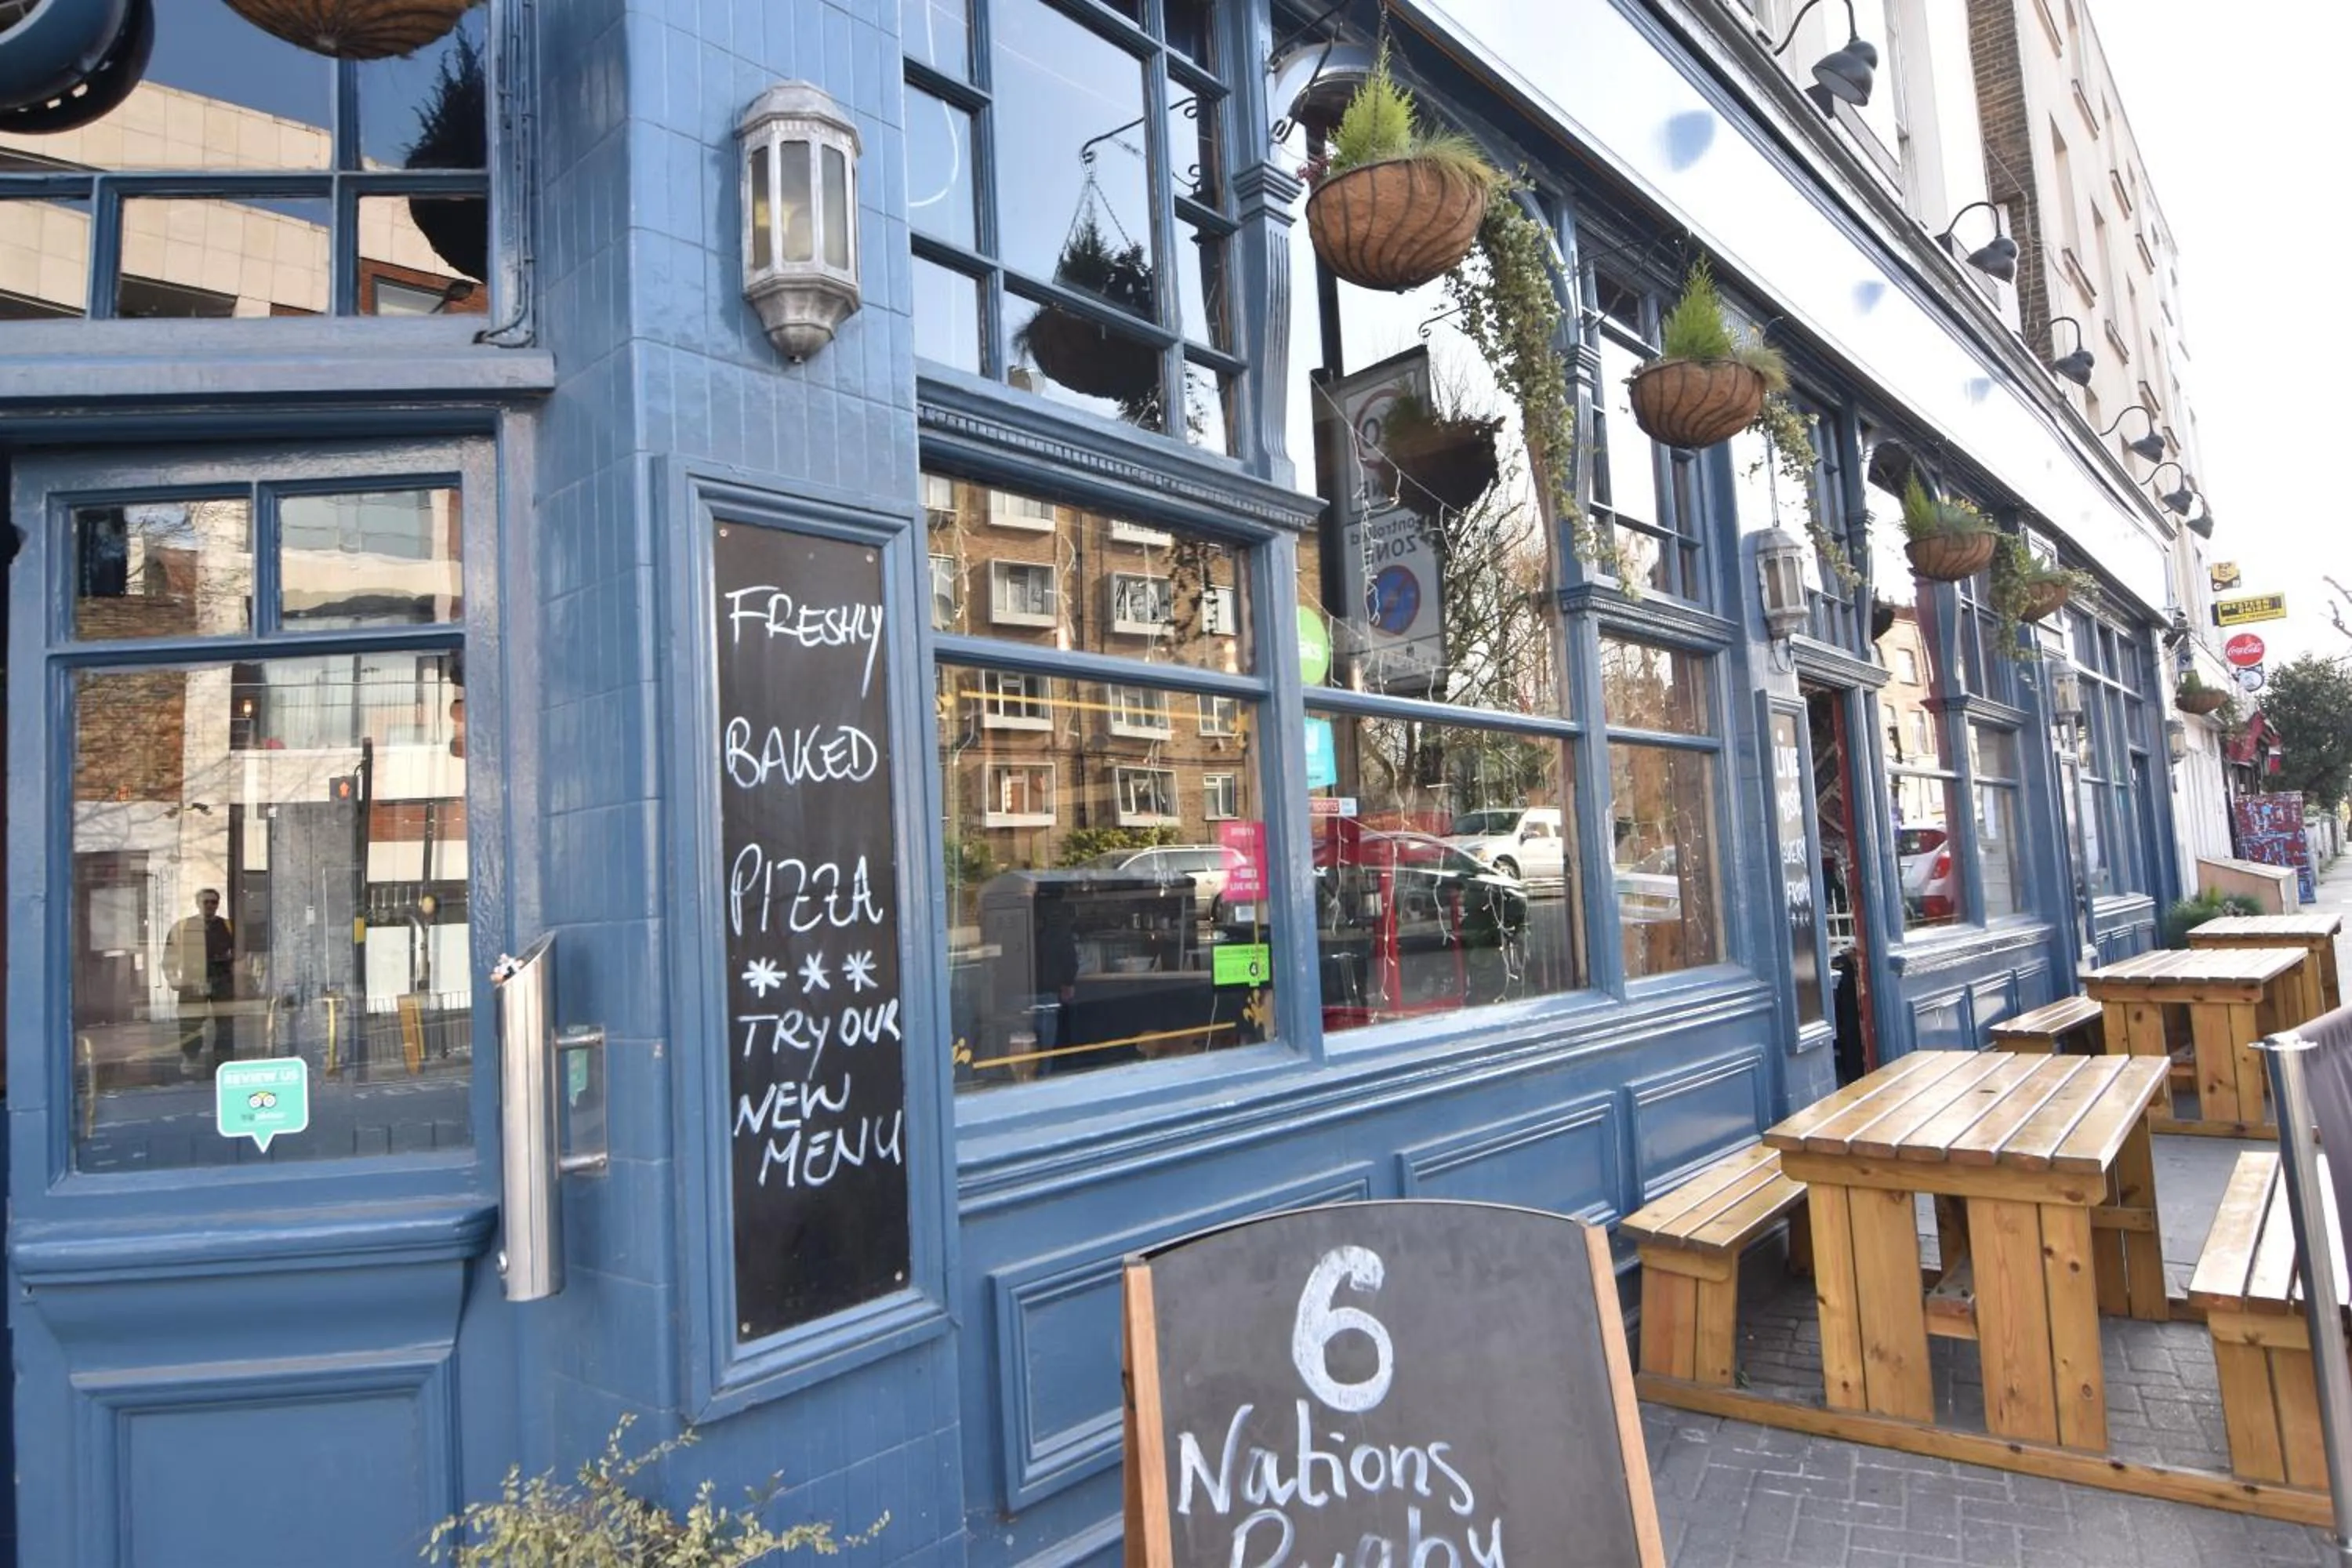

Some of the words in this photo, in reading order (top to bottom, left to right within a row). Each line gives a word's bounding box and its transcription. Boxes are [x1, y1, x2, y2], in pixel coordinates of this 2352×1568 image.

[724, 586, 884, 698] FRESHLY
[725, 716, 879, 788] BAKED
[730, 843, 884, 937] PIZZA
[739, 1009, 830, 1080] TRY
[839, 998, 901, 1047] OUR
[733, 1073, 851, 1138] NEW
[757, 1109, 902, 1188] MENU
[1292, 1245, 1394, 1412] 6
[1178, 1399, 1474, 1515] Nations
[1229, 1505, 1505, 1568] Rby
